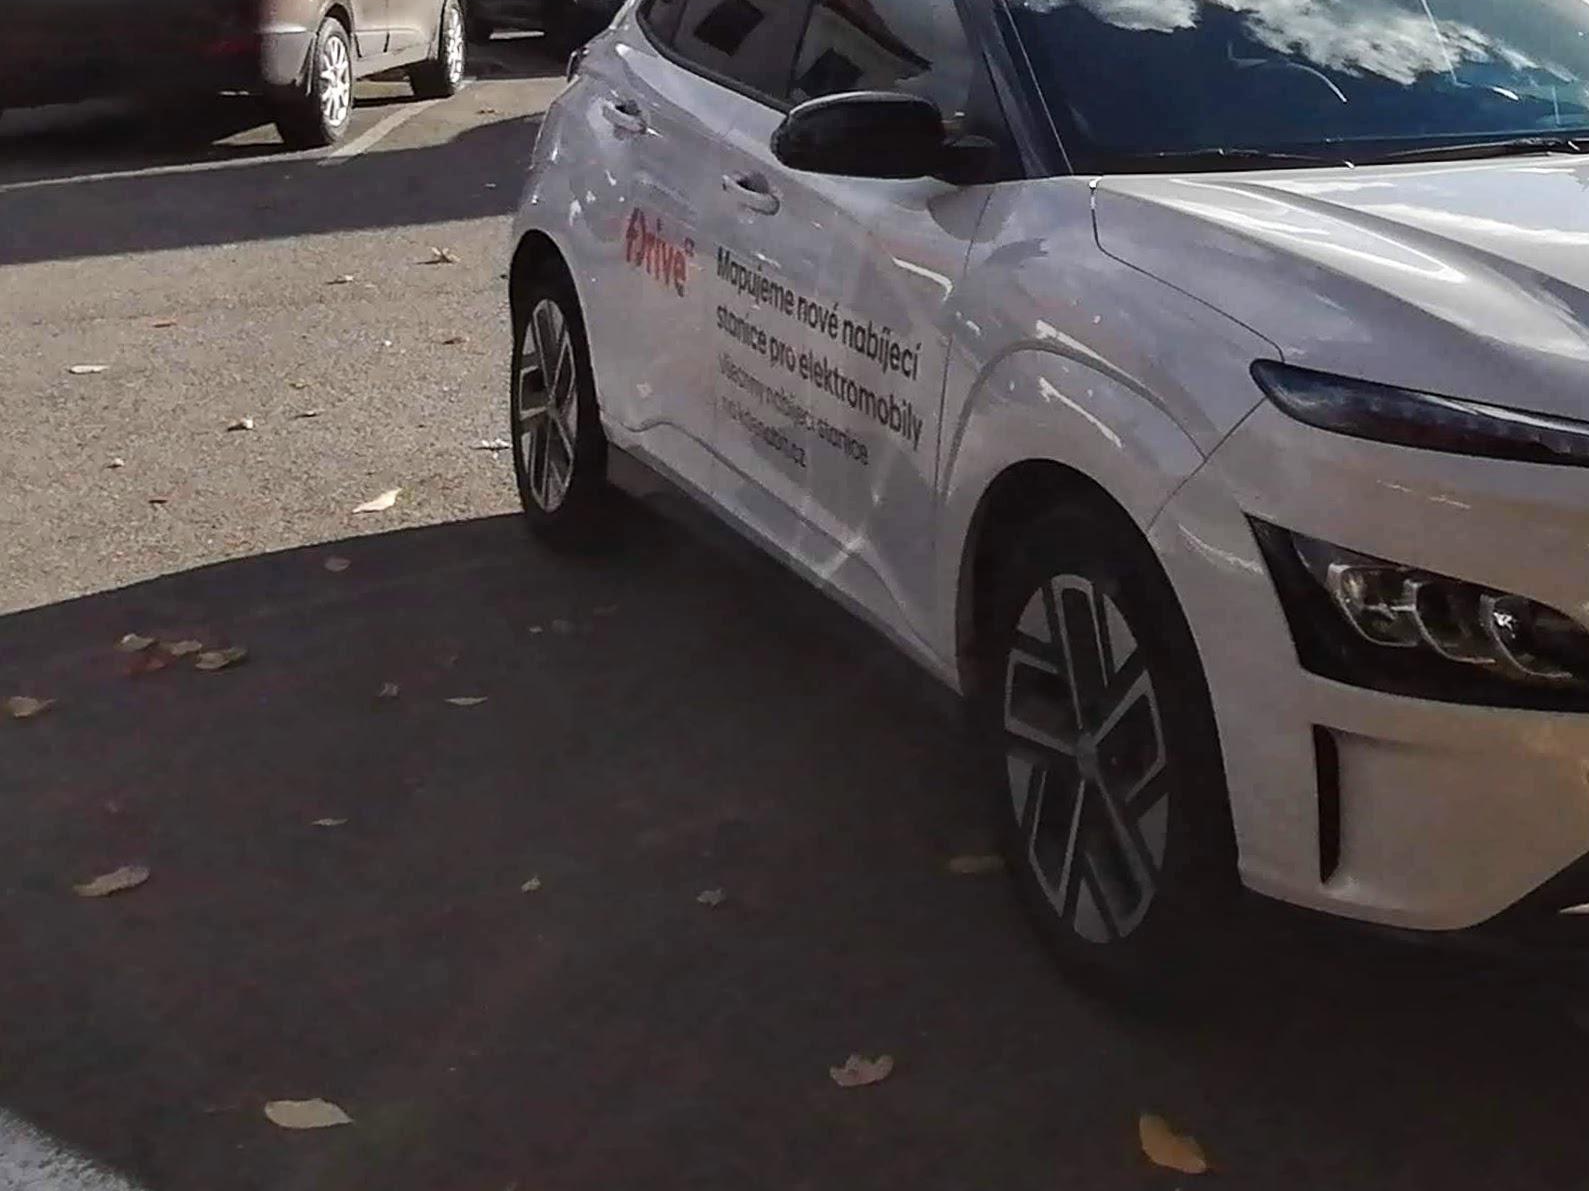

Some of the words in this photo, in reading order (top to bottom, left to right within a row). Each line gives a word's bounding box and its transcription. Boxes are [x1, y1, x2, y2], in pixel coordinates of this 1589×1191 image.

[716, 246, 795, 316] Mapujeme
[797, 296, 839, 339] nové
[842, 319, 922, 381] nabíjecí
[716, 305, 767, 355] stanice
[769, 336, 796, 370] pro
[799, 350, 923, 451] elektromobily
